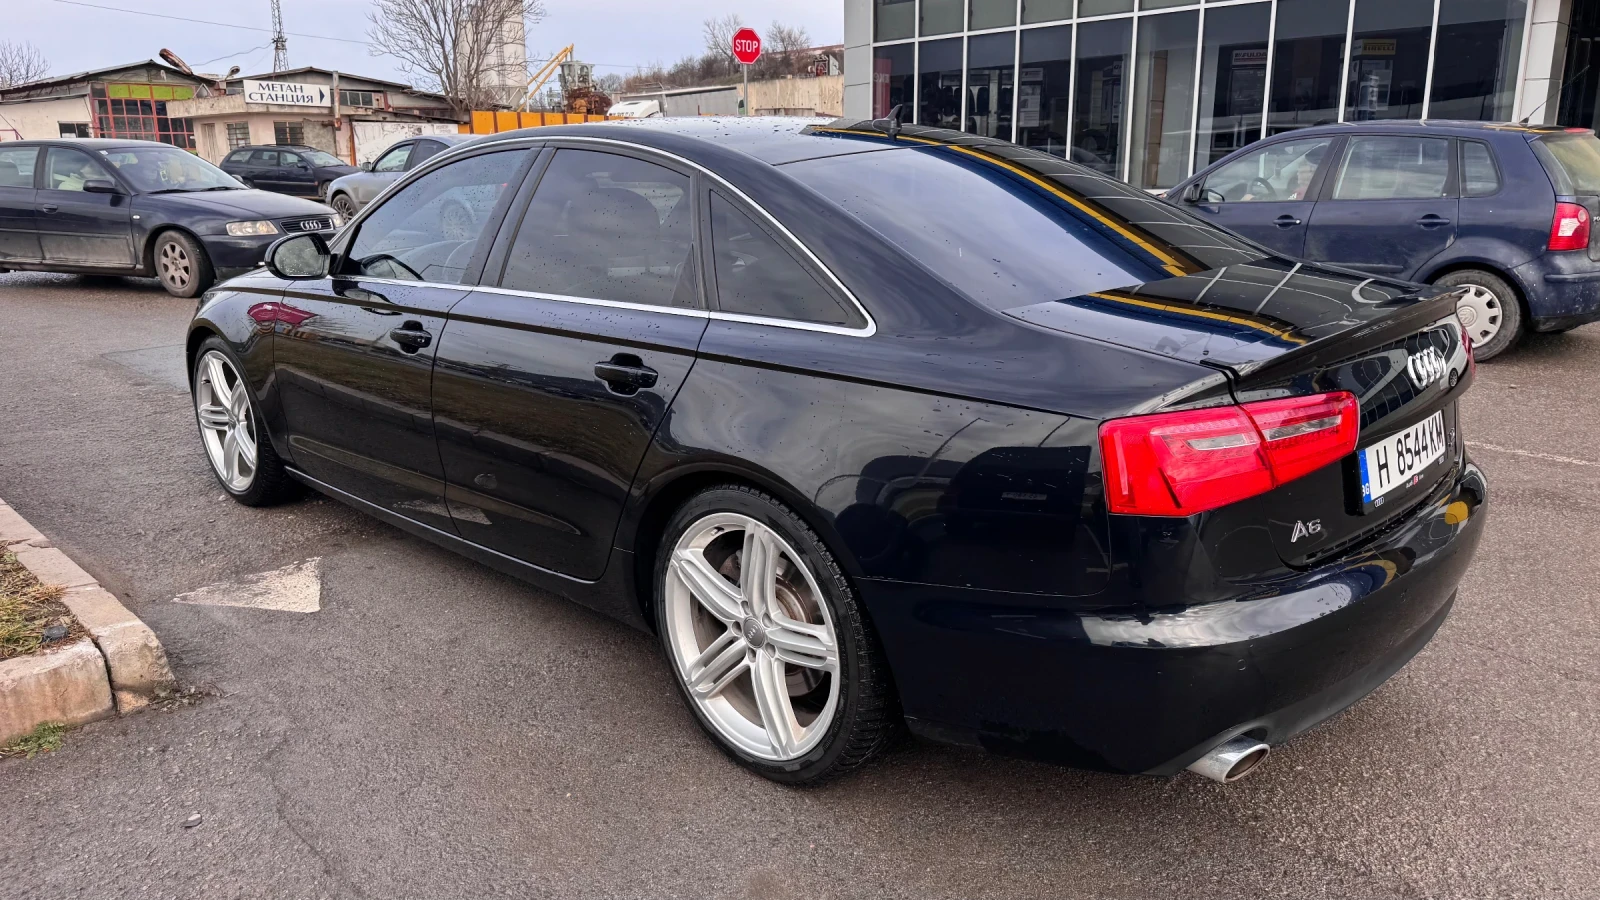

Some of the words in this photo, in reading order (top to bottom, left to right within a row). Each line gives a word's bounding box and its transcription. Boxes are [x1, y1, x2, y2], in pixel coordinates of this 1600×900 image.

[735, 39, 758, 52] STOP
[258, 83, 303, 93] МЕТАН
[248, 92, 314, 104] СТАНЦИЯ
[1376, 445, 1391, 489] H
[1290, 518, 1322, 543] A6
